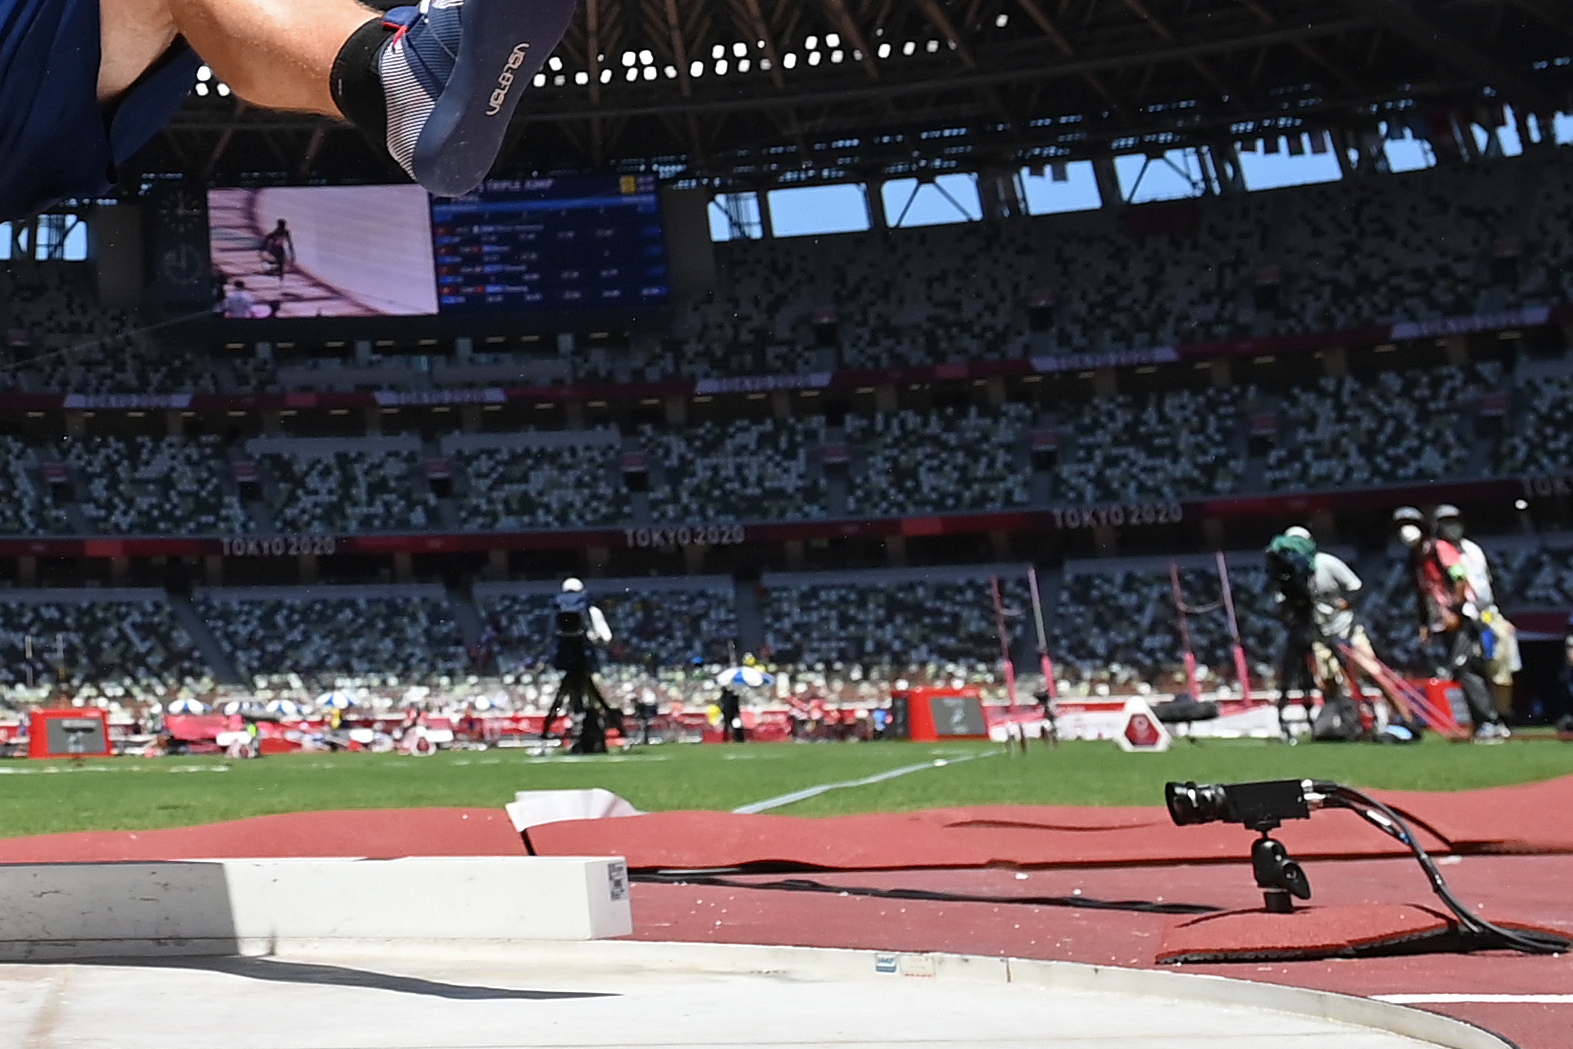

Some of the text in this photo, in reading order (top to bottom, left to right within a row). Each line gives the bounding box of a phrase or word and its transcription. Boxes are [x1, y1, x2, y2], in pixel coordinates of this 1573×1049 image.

[1052, 502, 1183, 529] TOKYO 2020
[222, 536, 335, 557] TOKYO 2020
[624, 524, 745, 548] TOKYO 2020
